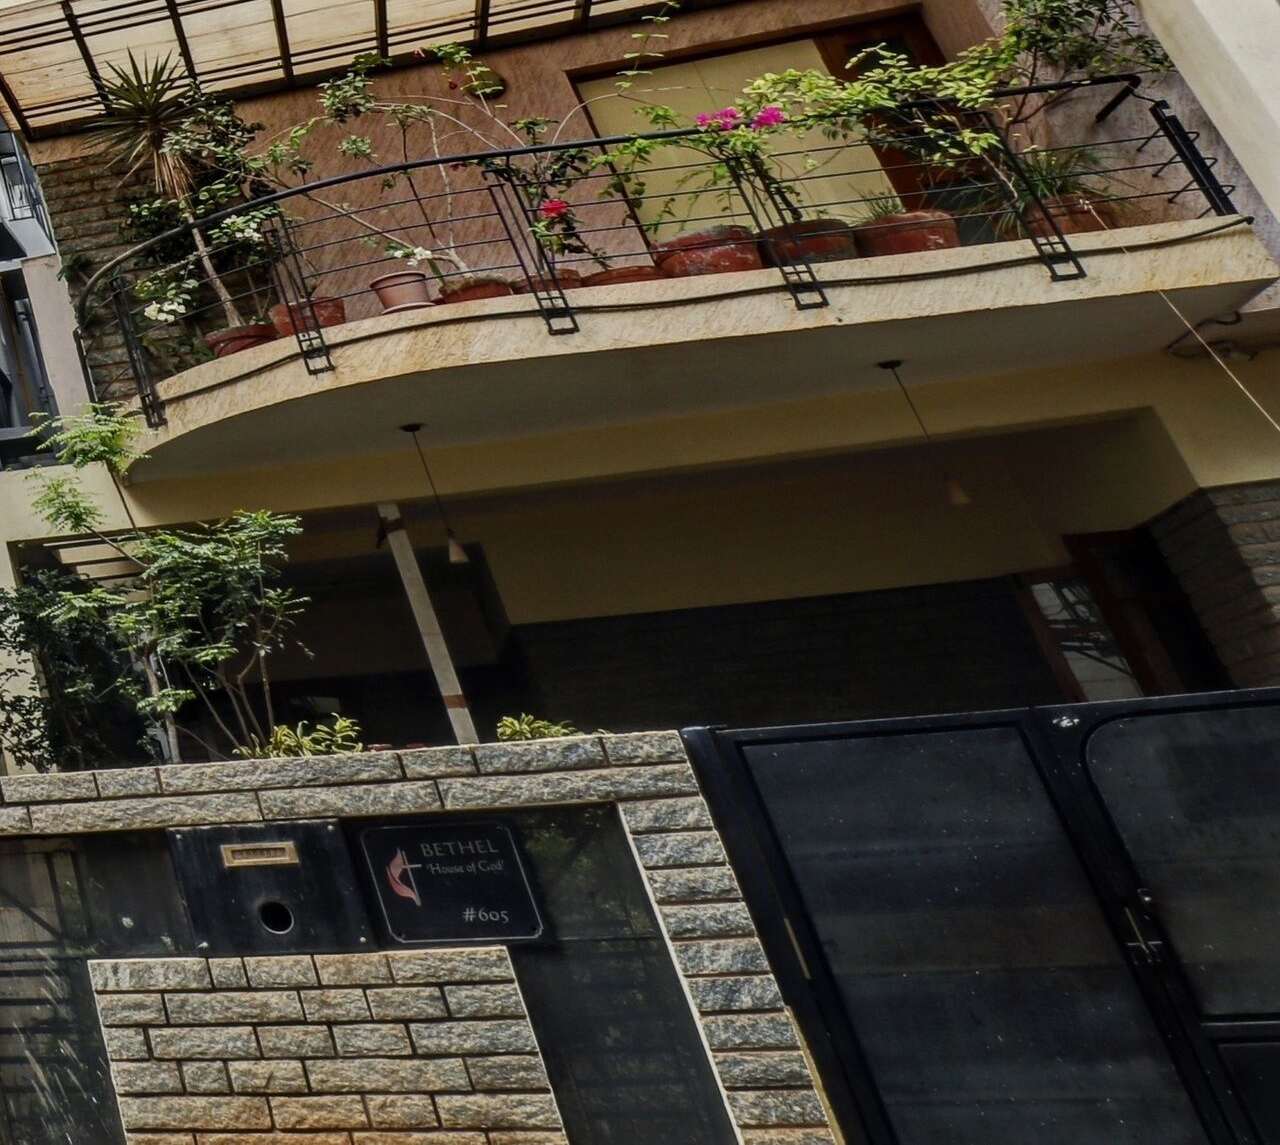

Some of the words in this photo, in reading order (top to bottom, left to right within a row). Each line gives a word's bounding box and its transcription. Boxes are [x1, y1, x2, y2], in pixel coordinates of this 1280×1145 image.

[420, 839, 500, 857] BETHEL
[466, 862, 477, 874] of
[462, 907, 509, 924] #605
